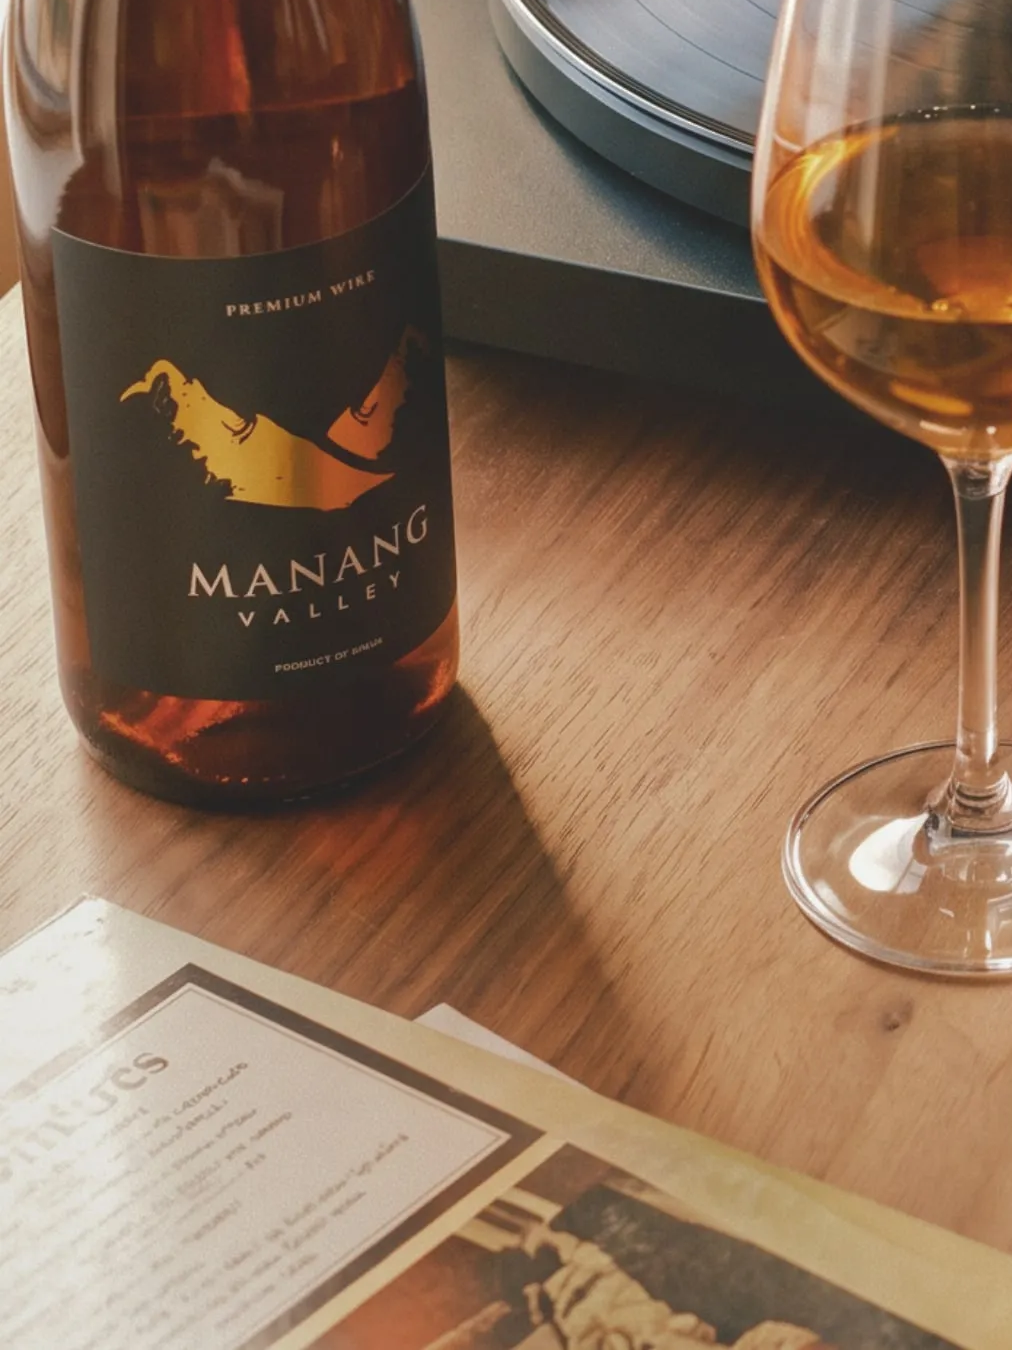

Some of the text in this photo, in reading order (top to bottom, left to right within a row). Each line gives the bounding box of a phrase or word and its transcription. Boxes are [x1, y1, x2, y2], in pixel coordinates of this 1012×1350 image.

[225, 289, 322, 317] PREMIUM
[187, 504, 428, 599] MANANG
[237, 570, 401, 628] VALLEY
